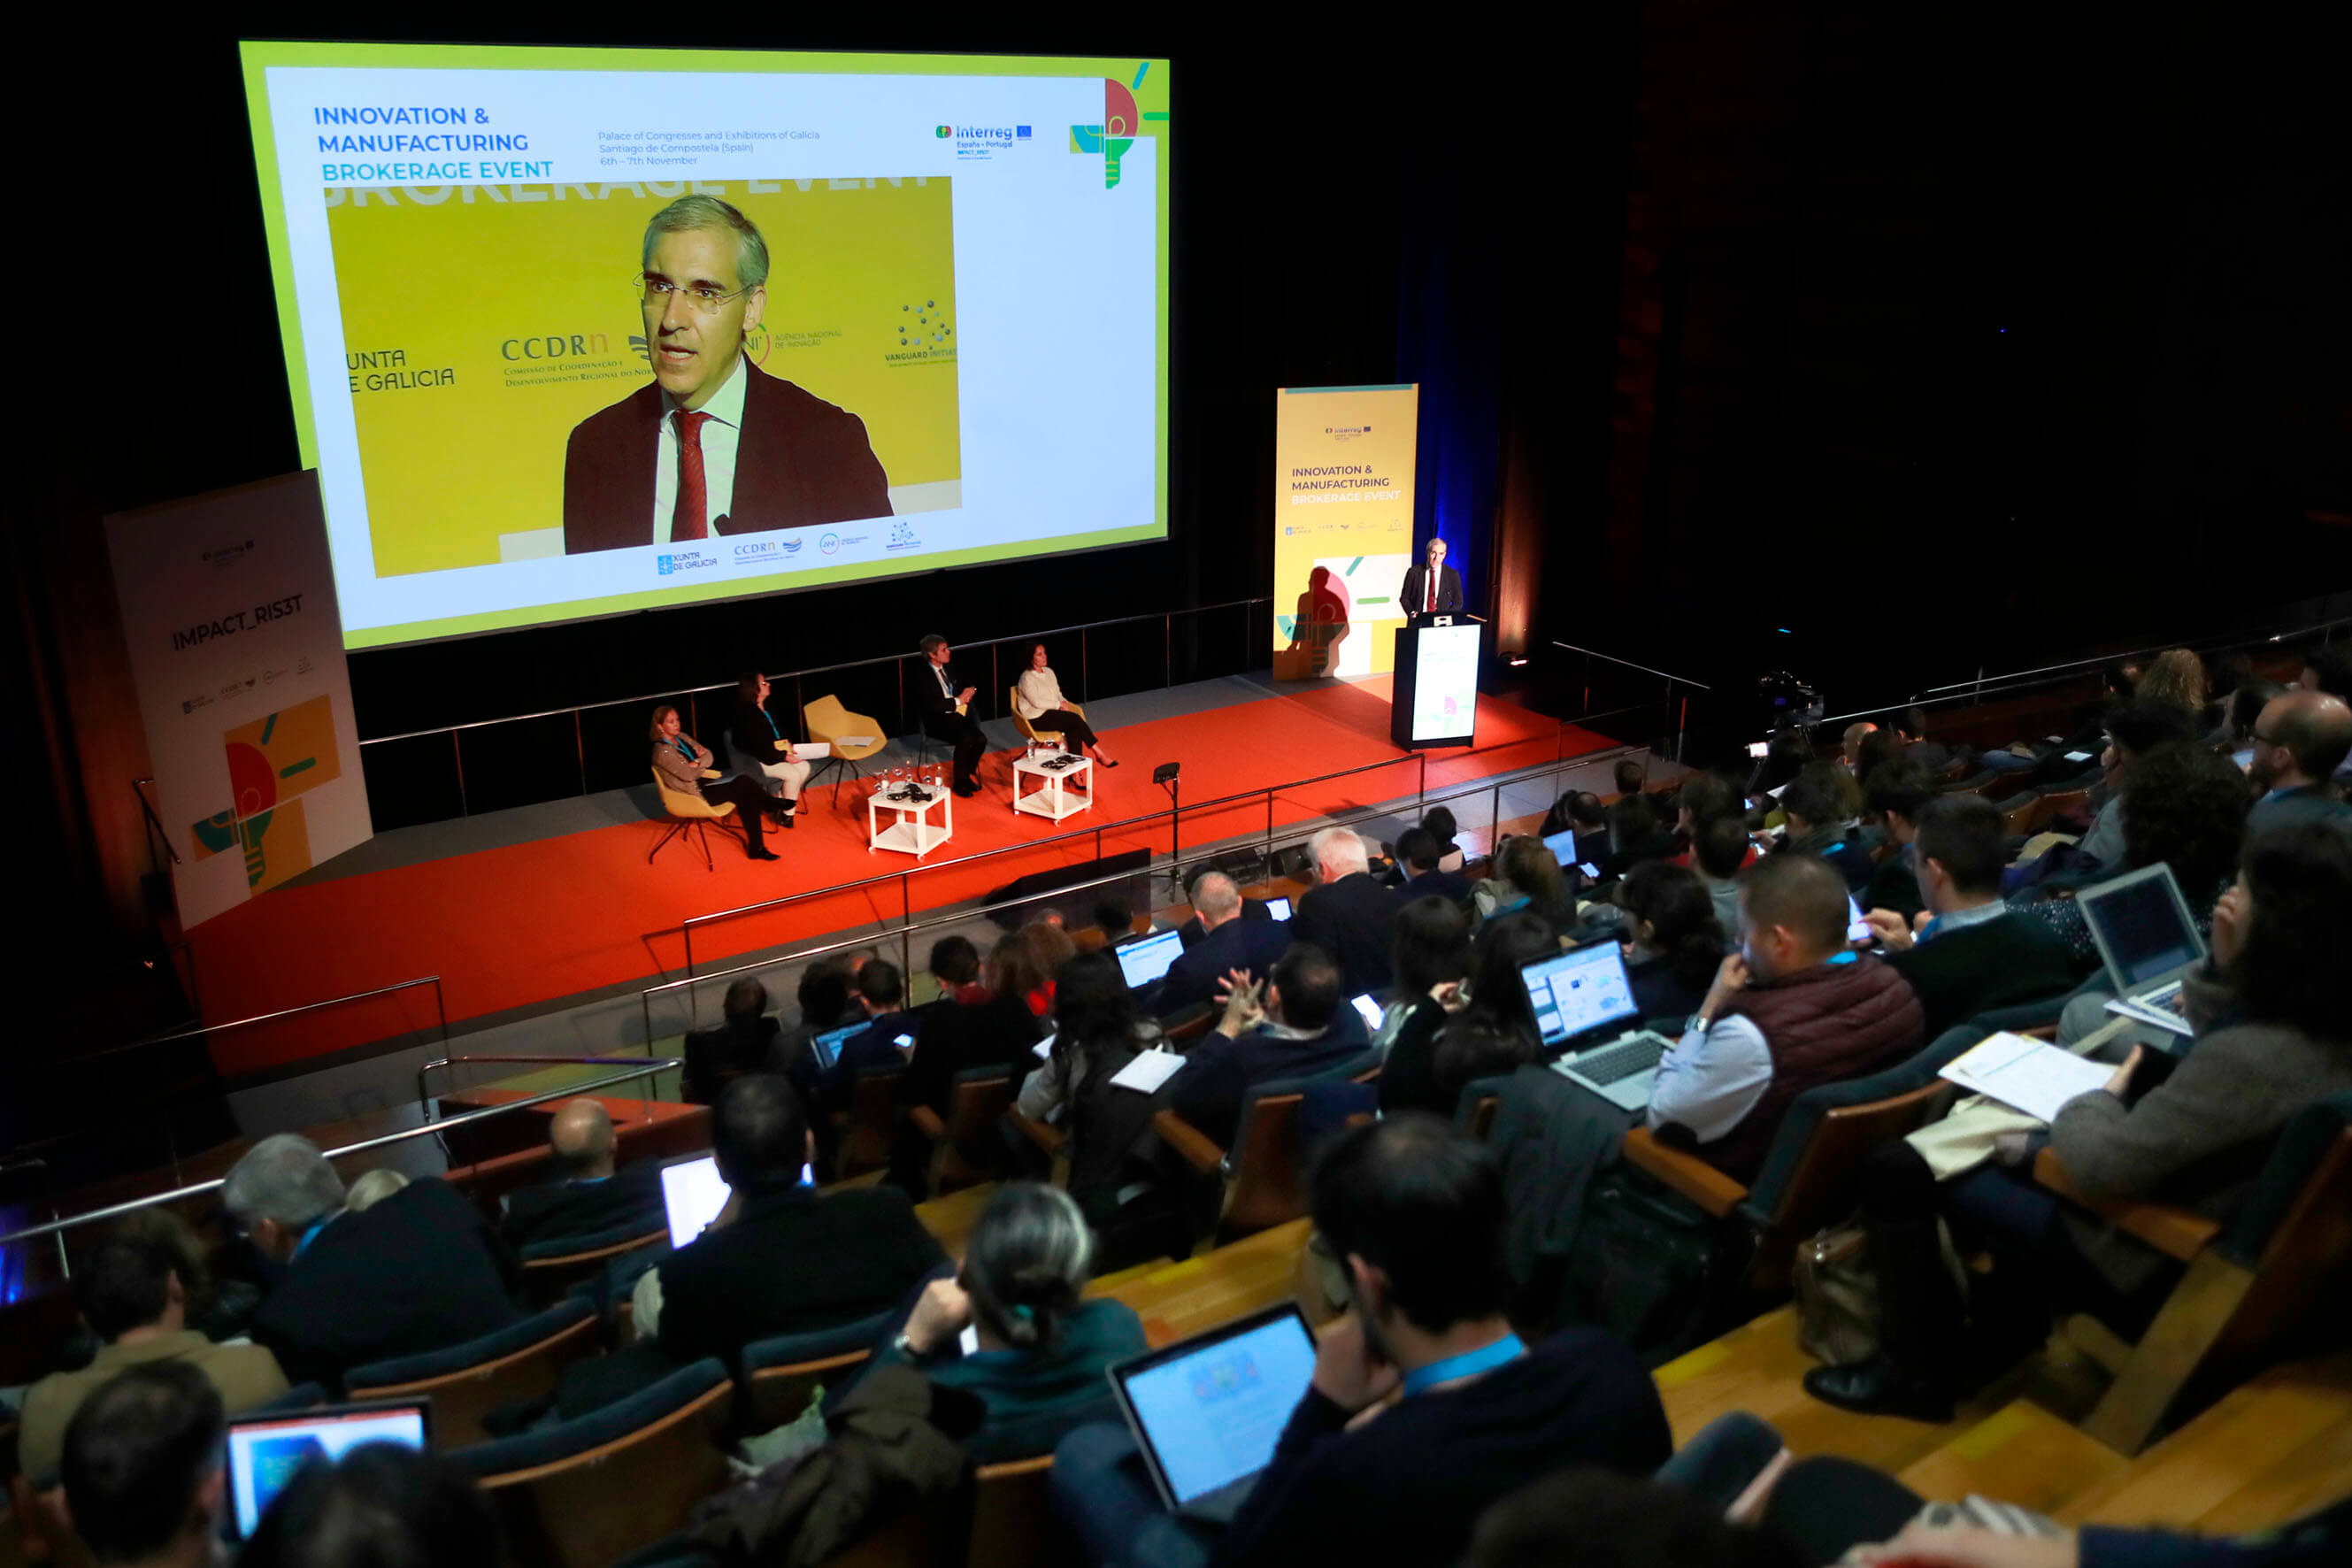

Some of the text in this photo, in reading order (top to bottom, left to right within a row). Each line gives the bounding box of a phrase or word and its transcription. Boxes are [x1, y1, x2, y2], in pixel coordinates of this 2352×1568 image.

[314, 106, 490, 126] INNOVATION &
[598, 130, 821, 143] Palace of Congresses and Exhibitions of Galicia
[957, 126, 1012, 140] Interreg
[318, 134, 529, 153] MANUFACTURING
[599, 142, 754, 155] Santiago de Compostela (Spain)
[986, 141, 1013, 150] Portugal
[600, 157, 618, 166] 6th
[626, 157, 644, 165] 7th
[646, 156, 697, 165] November
[322, 160, 554, 181] BROKERAGE EVENT
[347, 350, 406, 370] UNTA
[885, 350, 928, 362] VANGUARD
[350, 368, 455, 393] E GALICIA
[1292, 465, 1372, 478] INNOVATION &
[1292, 478, 1390, 491] MANUFACTURING
[1292, 489, 1402, 504] BROKERAGE EVENT
[673, 551, 701, 562] XUNTA
[673, 557, 718, 571] DE GALICIA
[172, 594, 304, 651] IMPACT_RIS3T
